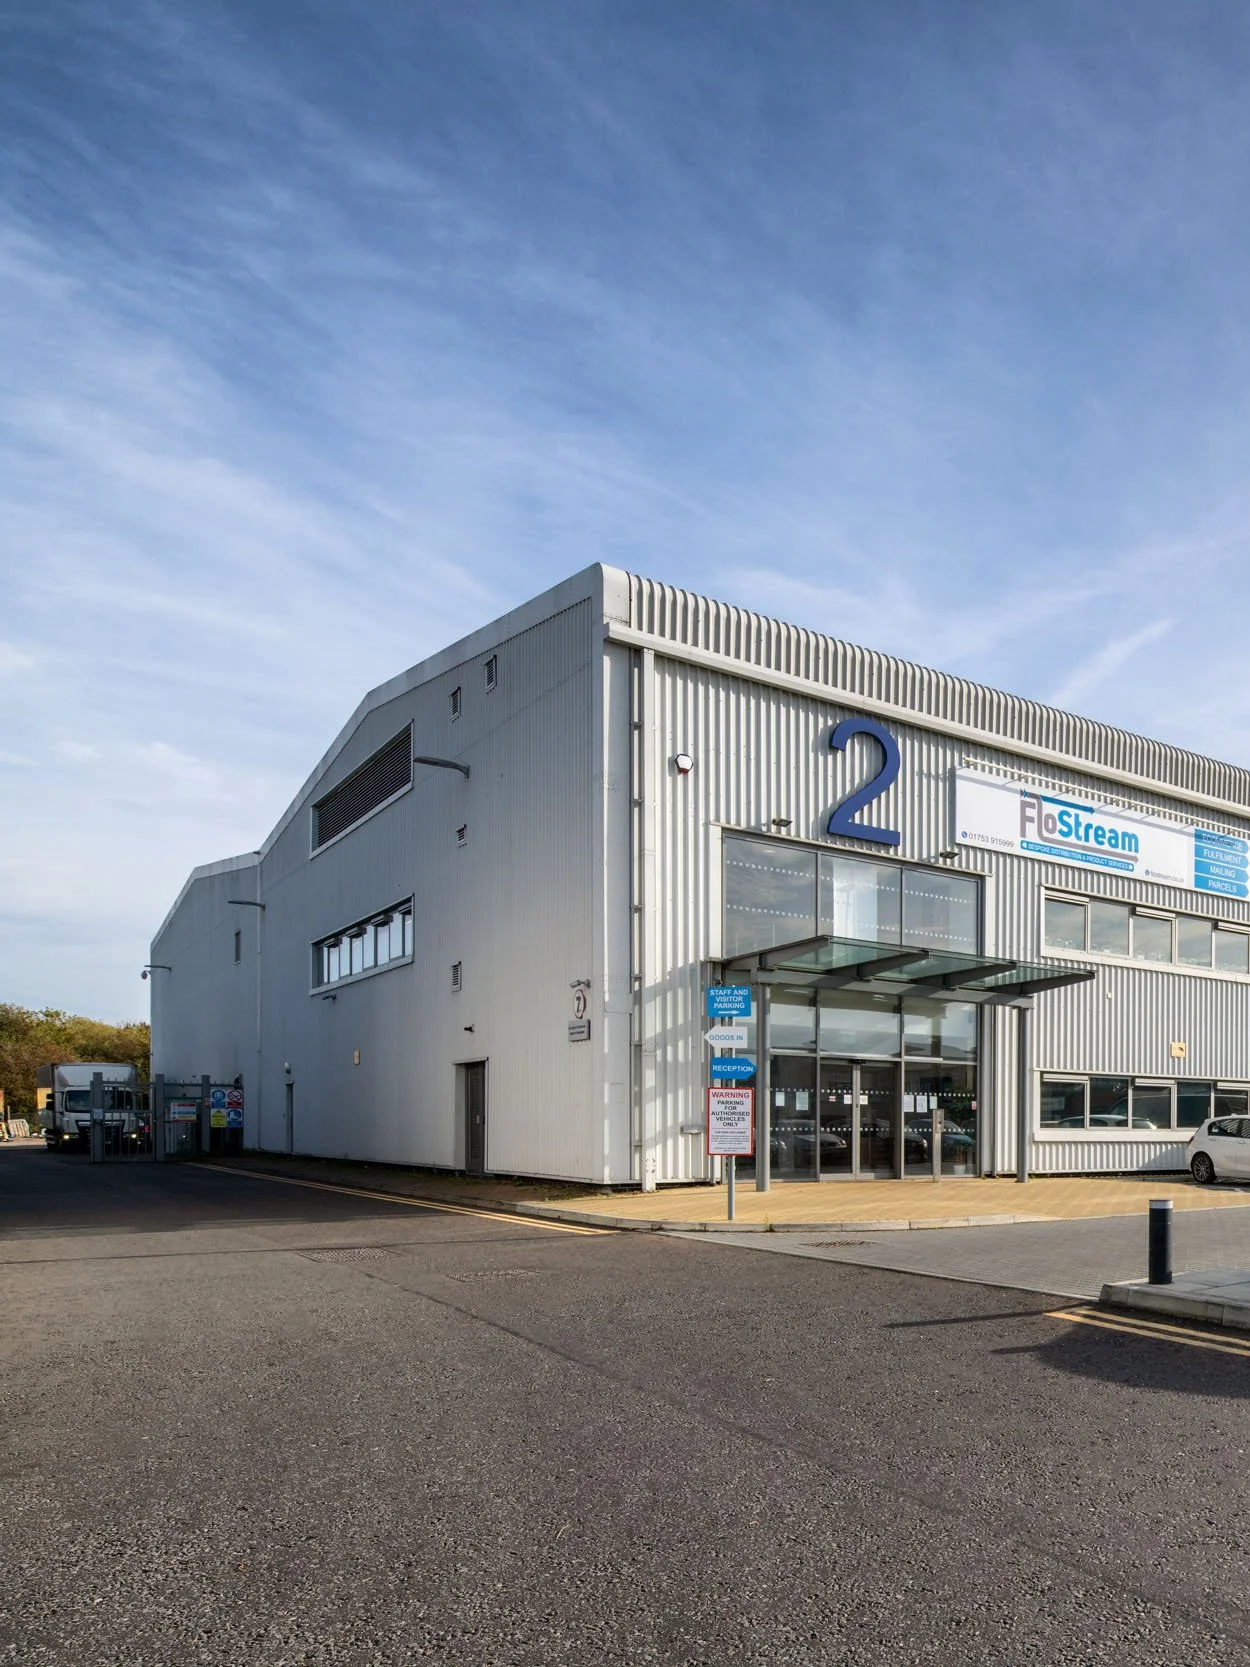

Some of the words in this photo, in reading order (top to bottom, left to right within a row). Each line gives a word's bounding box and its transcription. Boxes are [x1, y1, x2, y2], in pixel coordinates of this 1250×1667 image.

[827, 717, 901, 846] 2
[1020, 795, 1139, 854] FloStream
[969, 832, 989, 843] 01753
[1203, 848, 1241, 864] FULFILMENT
[1209, 865, 1236, 878] MAILING
[1208, 879, 1237, 893] PARCELS
[712, 1064, 754, 1072] RECEPTION
[711, 1091, 750, 1099] WARNING
